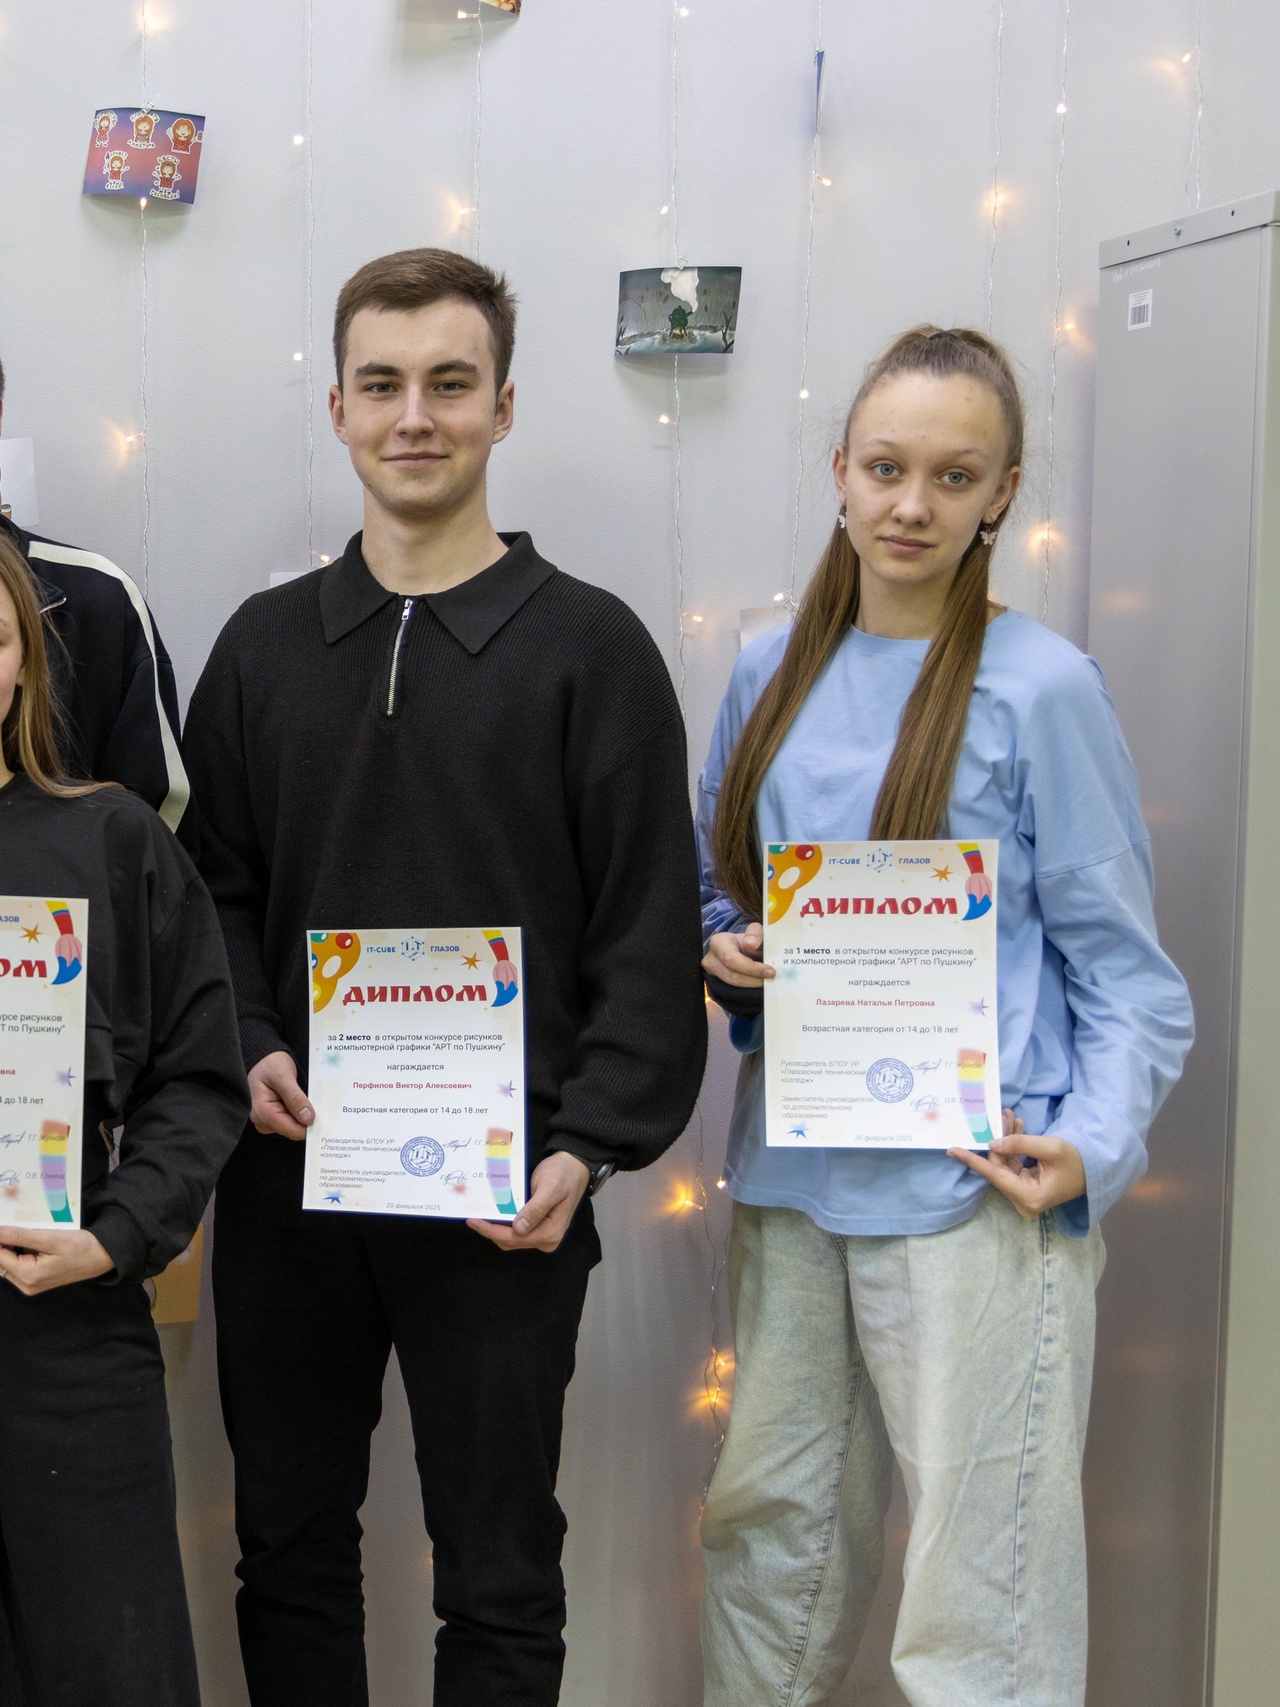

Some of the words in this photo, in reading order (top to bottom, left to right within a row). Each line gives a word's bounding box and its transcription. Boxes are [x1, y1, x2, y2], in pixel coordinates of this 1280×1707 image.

[800, 897, 957, 917] ДИПЛОМ
[842, 948, 886, 956] открытом
[889, 948, 930, 956] конкурсе
[932, 949, 974, 957] рисунков
[790, 957, 856, 966] компьютерной
[858, 957, 896, 967] графики
[848, 979, 910, 987] награждается
[343, 985, 487, 1005] ДИПЛОМ
[816, 998, 855, 1007] Лазарева
[894, 999, 935, 1008] Петровна
[20, 1014, 62, 1023] рисунков
[802, 1024, 850, 1033] Возрастная
[852, 1026, 894, 1034] категория
[908, 1025, 917, 1033] 14
[932, 1025, 942, 1033] 18
[338, 1033, 344, 1041] 2
[424, 1034, 462, 1042] конкурсе
[464, 1034, 503, 1042] рисунков
[334, 1043, 395, 1052] компьютерной
[396, 1043, 431, 1052] графики
[387, 1064, 444, 1072] награждается
[353, 1081, 394, 1090] Перфилов
[395, 1082, 424, 1090] Виктор
